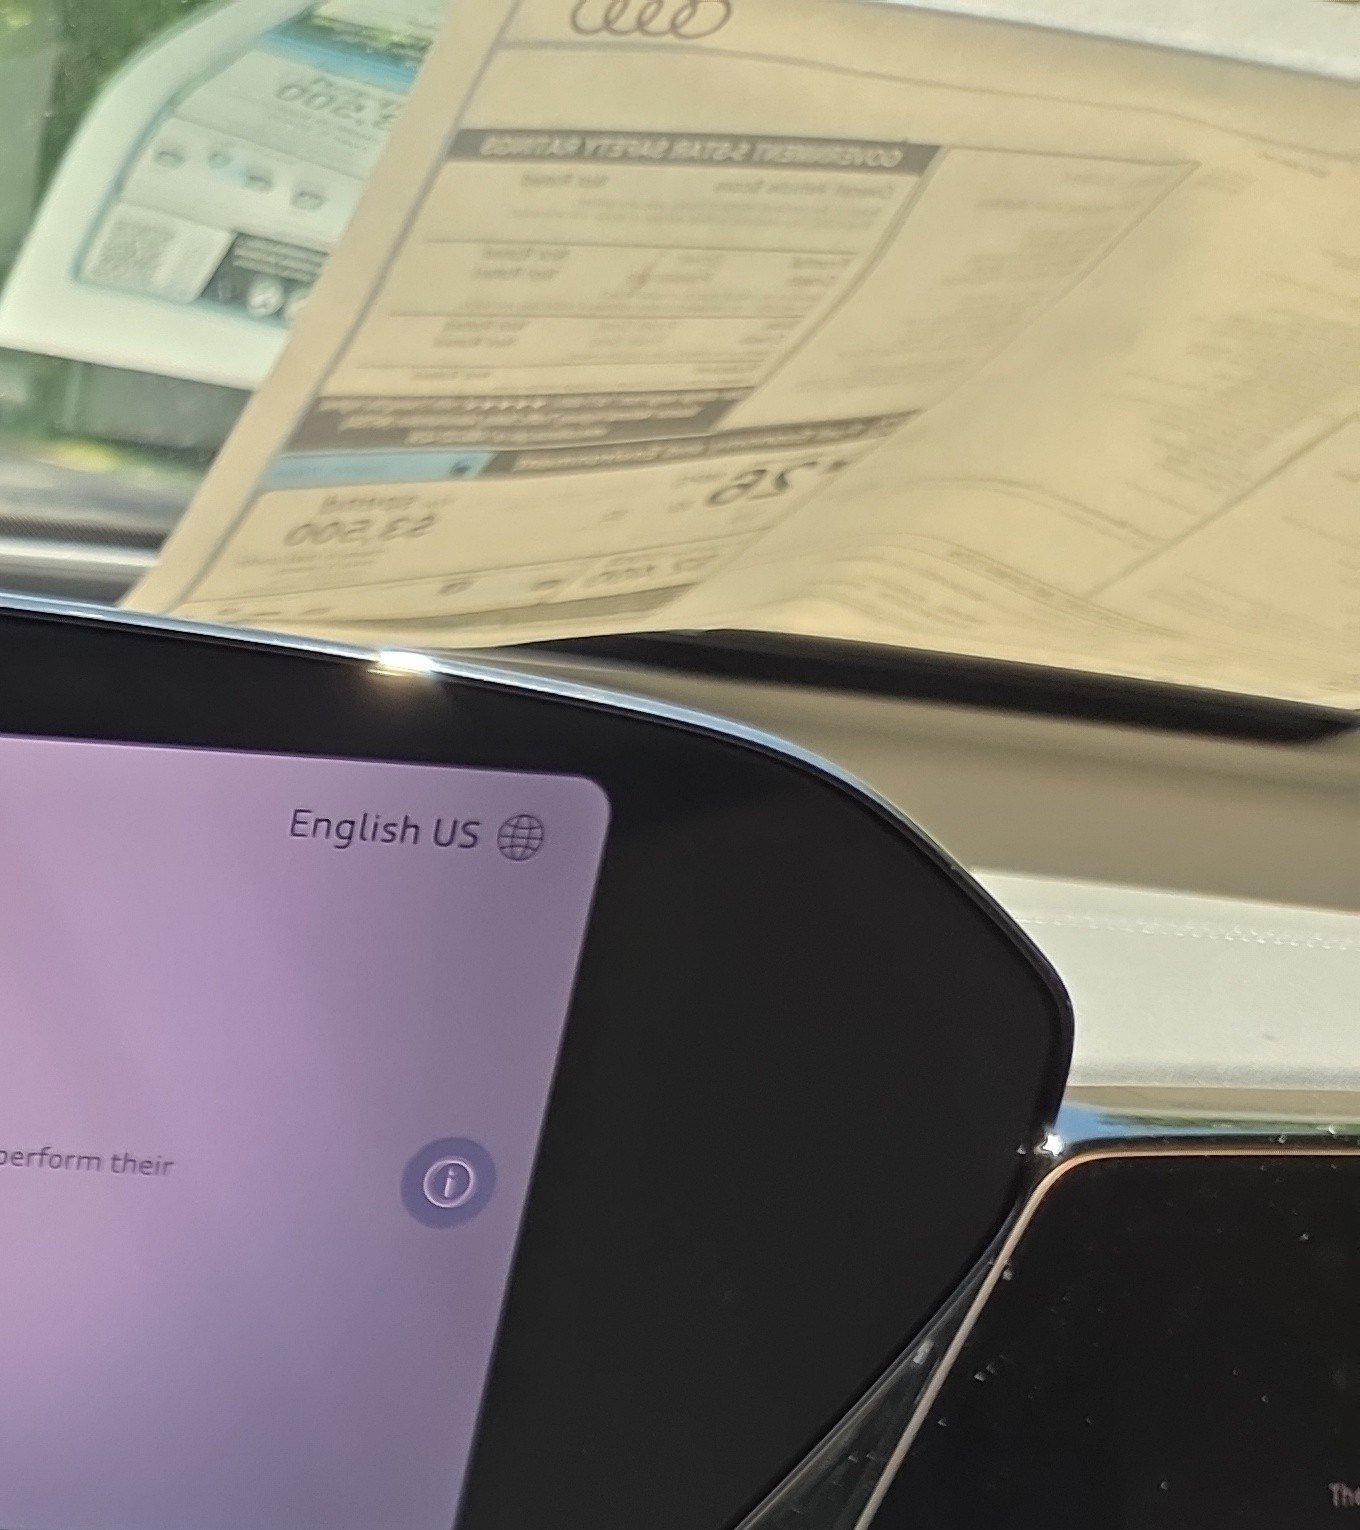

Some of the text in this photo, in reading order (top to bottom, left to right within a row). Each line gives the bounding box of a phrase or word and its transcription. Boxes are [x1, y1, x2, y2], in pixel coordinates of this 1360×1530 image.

[289, 808, 482, 850] English US
[111, 1152, 176, 1176] their
